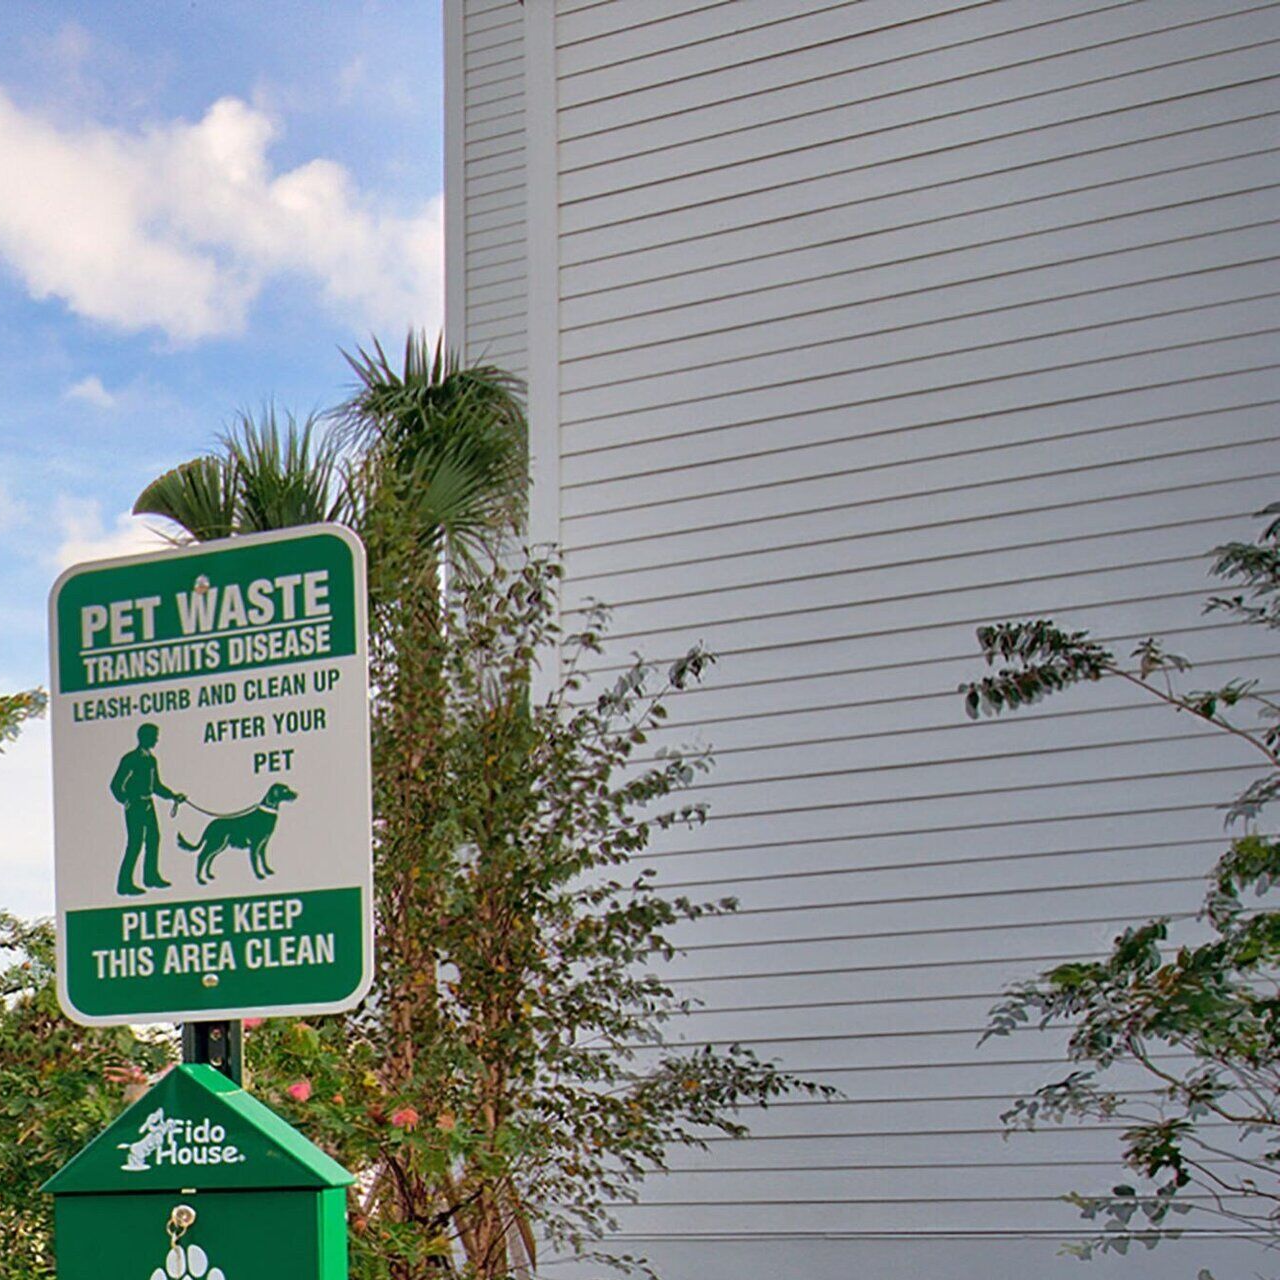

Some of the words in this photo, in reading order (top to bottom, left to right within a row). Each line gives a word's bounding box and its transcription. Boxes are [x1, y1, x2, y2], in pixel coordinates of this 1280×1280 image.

[81, 597, 161, 648] PET
[176, 570, 330, 636] WASTE
[83, 640, 221, 684] TRANSMITS
[229, 625, 331, 666] DISEASE
[73, 689, 191, 722] LEASH-CURB
[198, 683, 236, 708] AND
[244, 674, 306, 700] CLEAN
[314, 669, 340, 692] UP
[204, 716, 265, 743] AFTER
[274, 708, 326, 734] YOUR
[254, 750, 294, 774] PET
[122, 905, 223, 942] PLEASE
[234, 899, 302, 932] KEEP
[93, 947, 155, 979] THIS
[164, 942, 236, 975] AREA
[245, 933, 335, 969] CLEAN
[167, 1118, 225, 1144] Fido
